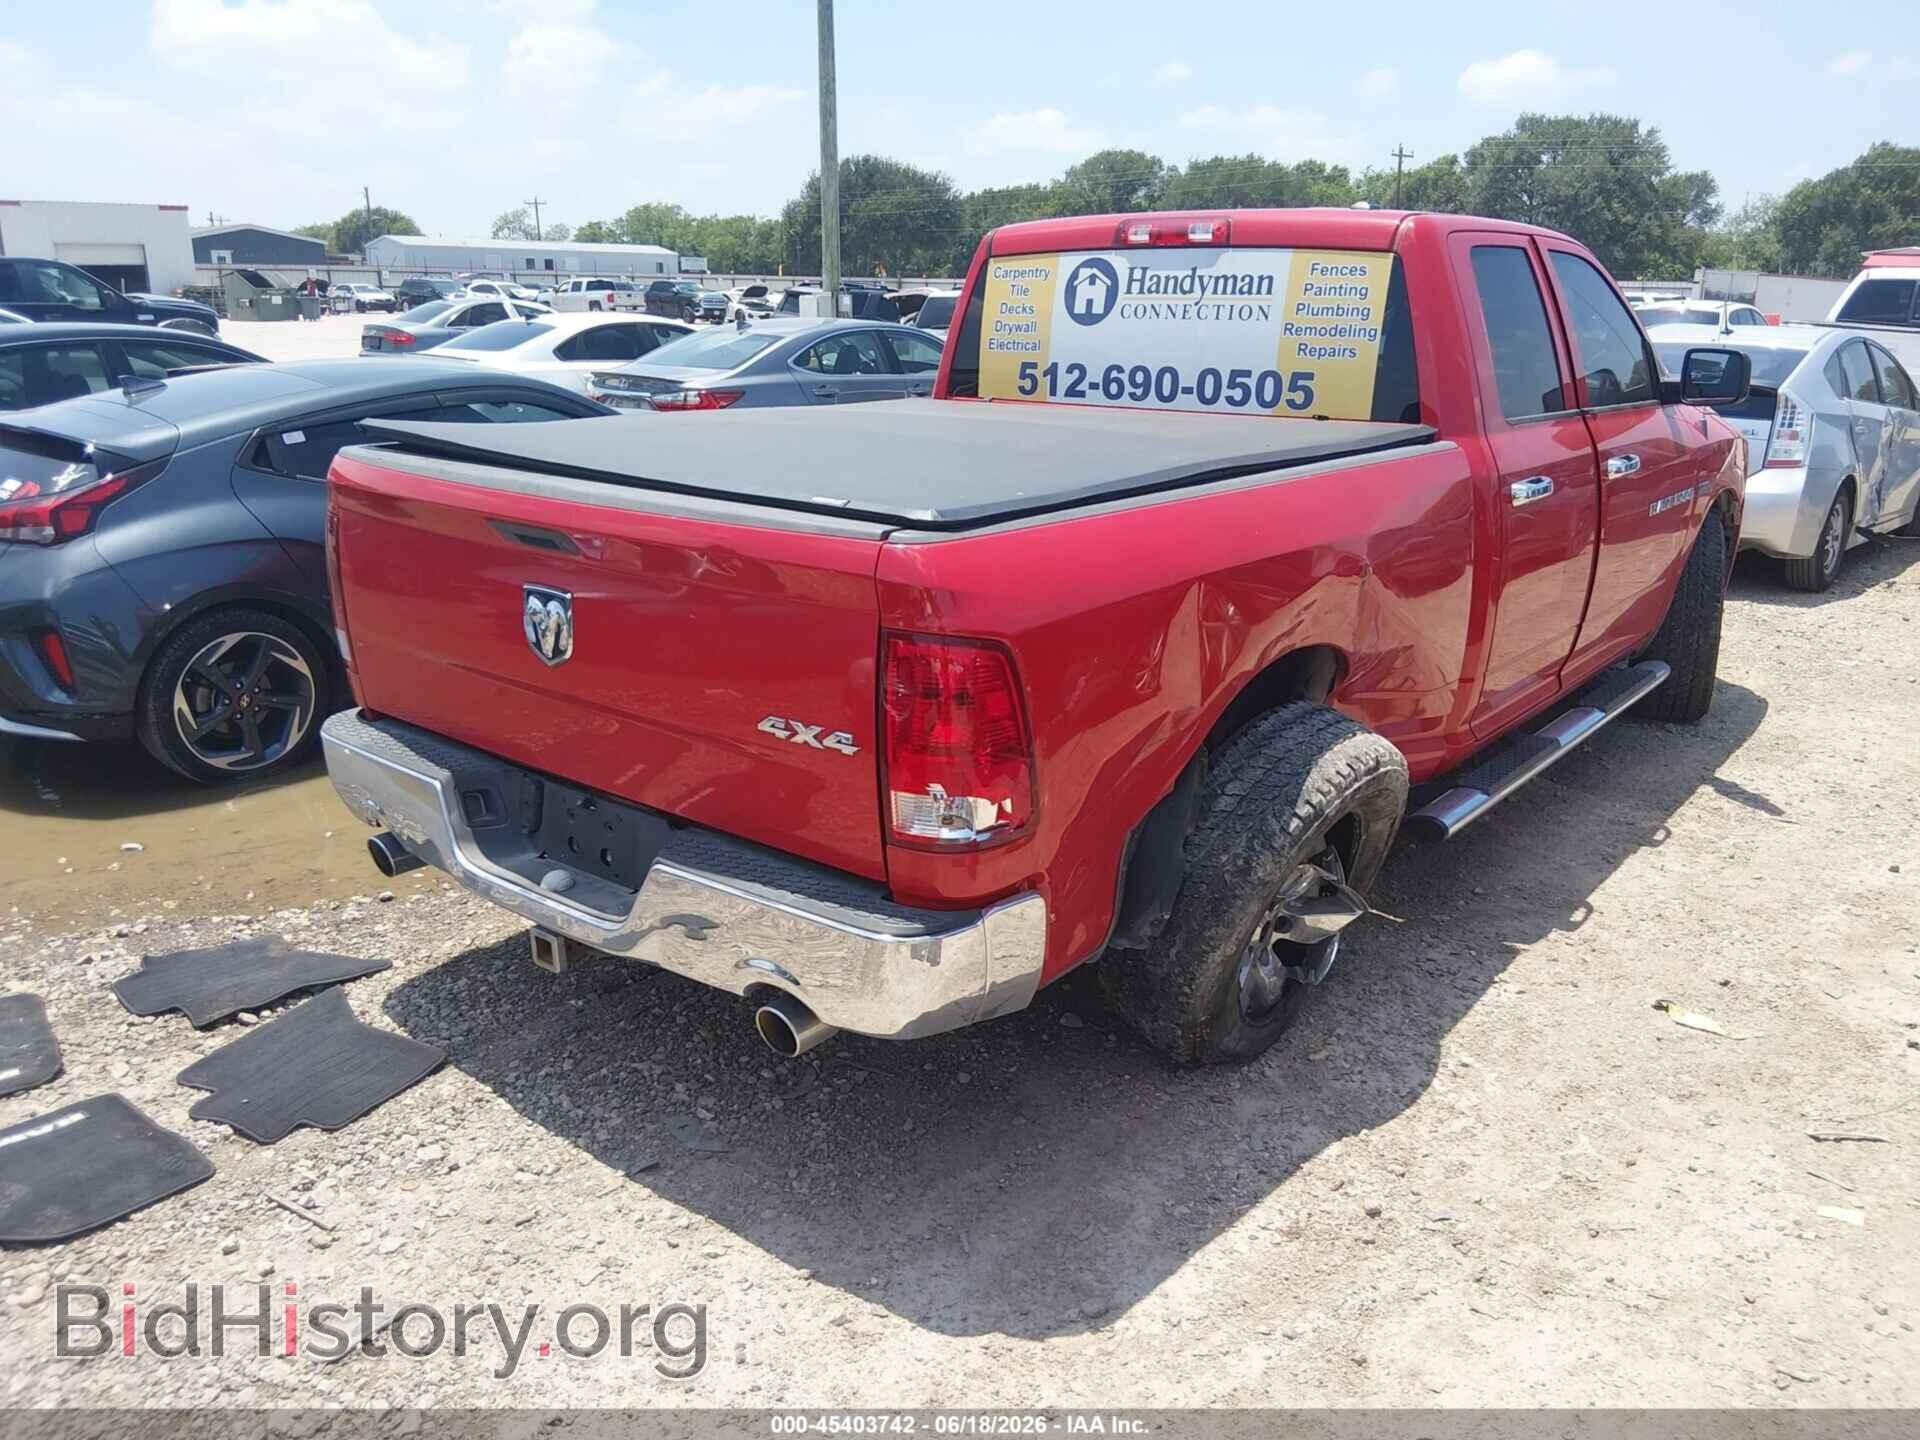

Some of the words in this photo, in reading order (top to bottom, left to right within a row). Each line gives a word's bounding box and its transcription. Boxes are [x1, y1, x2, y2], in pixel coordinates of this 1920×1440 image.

[993, 266, 1050, 281] Carpentry
[1310, 262, 1368, 277] Fences
[1010, 284, 1030, 297] Tile
[1124, 265, 1274, 307] Handyman
[1303, 282, 1369, 301] Painting
[1000, 302, 1034, 315] Decks
[1120, 303, 1271, 322] CONNECTION
[1295, 302, 1371, 321] Plumbing
[994, 320, 1037, 335] Drywall
[1283, 322, 1378, 342] Remodeling
[988, 338, 1041, 352] Electrical
[1297, 343, 1357, 360] Repairs
[1017, 361, 1315, 411] 512-690-0505
